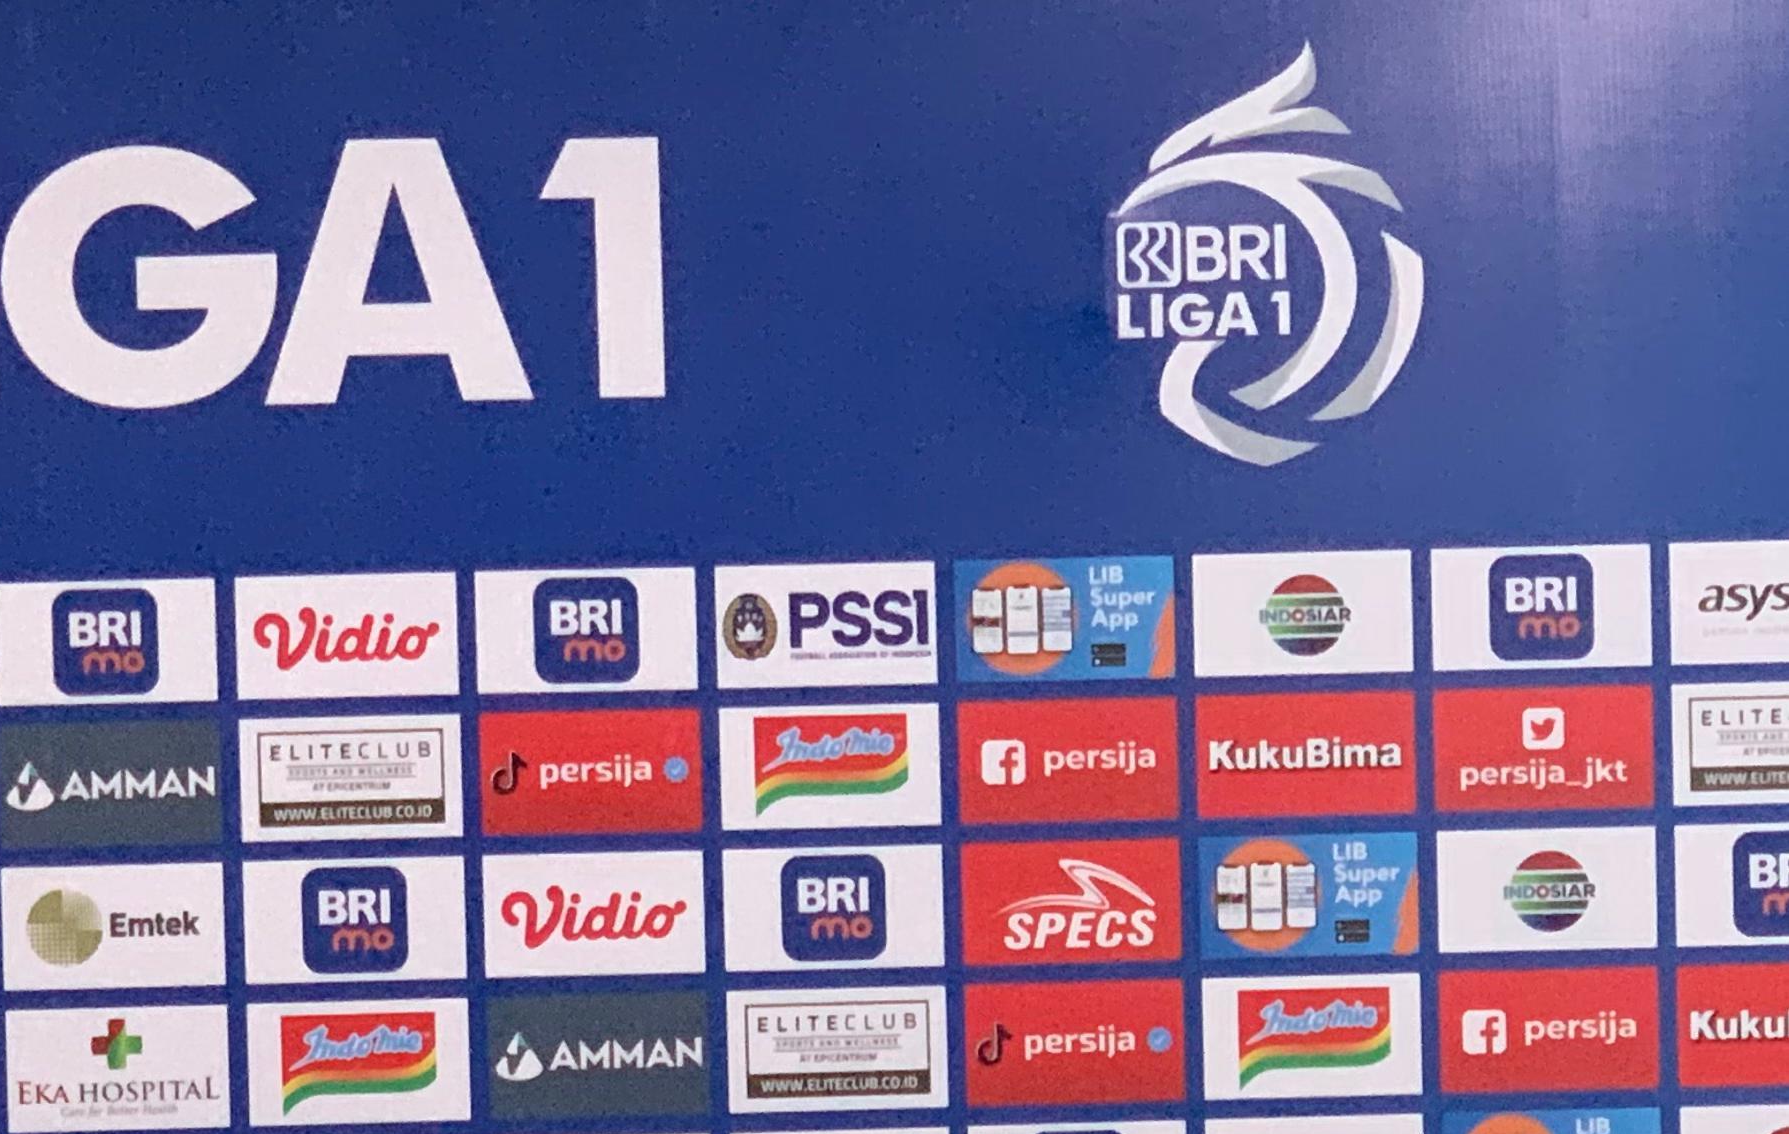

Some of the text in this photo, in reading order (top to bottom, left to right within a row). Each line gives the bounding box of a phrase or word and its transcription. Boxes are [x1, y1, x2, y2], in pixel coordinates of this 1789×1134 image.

[539, 136, 666, 400] 1
[1184, 223, 1288, 283] BRI
[1117, 291, 1291, 340] LIGA 1
[1088, 565, 1123, 584] LIB
[1090, 589, 1156, 612] Super
[1504, 576, 1577, 612] BRI
[67, 611, 142, 647] BRI
[548, 599, 621, 636] BRI
[788, 590, 929, 648] PSSI
[1092, 609, 1138, 629] App
[253, 606, 440, 670] Vidio
[1700, 708, 1789, 727] ELITE
[269, 741, 432, 762] ELITECLUB
[1042, 742, 1156, 776] persija
[1208, 736, 1401, 772] KukuBima
[59, 765, 215, 802] AMMAN
[538, 753, 652, 789] persija
[1459, 757, 1628, 791] persija_jkt
[1332, 842, 1367, 861] LIB
[1334, 864, 1399, 887] Super
[1503, 882, 1594, 900] INDOSIAR
[316, 888, 390, 924] BRI
[795, 876, 868, 913] BRI
[1335, 884, 1381, 905] App
[109, 910, 200, 937] Emtek
[500, 885, 686, 949] Vidio
[1003, 909, 1155, 951] SPECS
[756, 1012, 917, 1033] ELITECLUB
[1523, 1012, 1636, 1045] persija
[1690, 1009, 1789, 1042] Kuku
[548, 1035, 702, 1072] AMMAN
[1024, 1025, 1136, 1060] persija
[17, 1075, 218, 1105] EKA HOSPITAL
